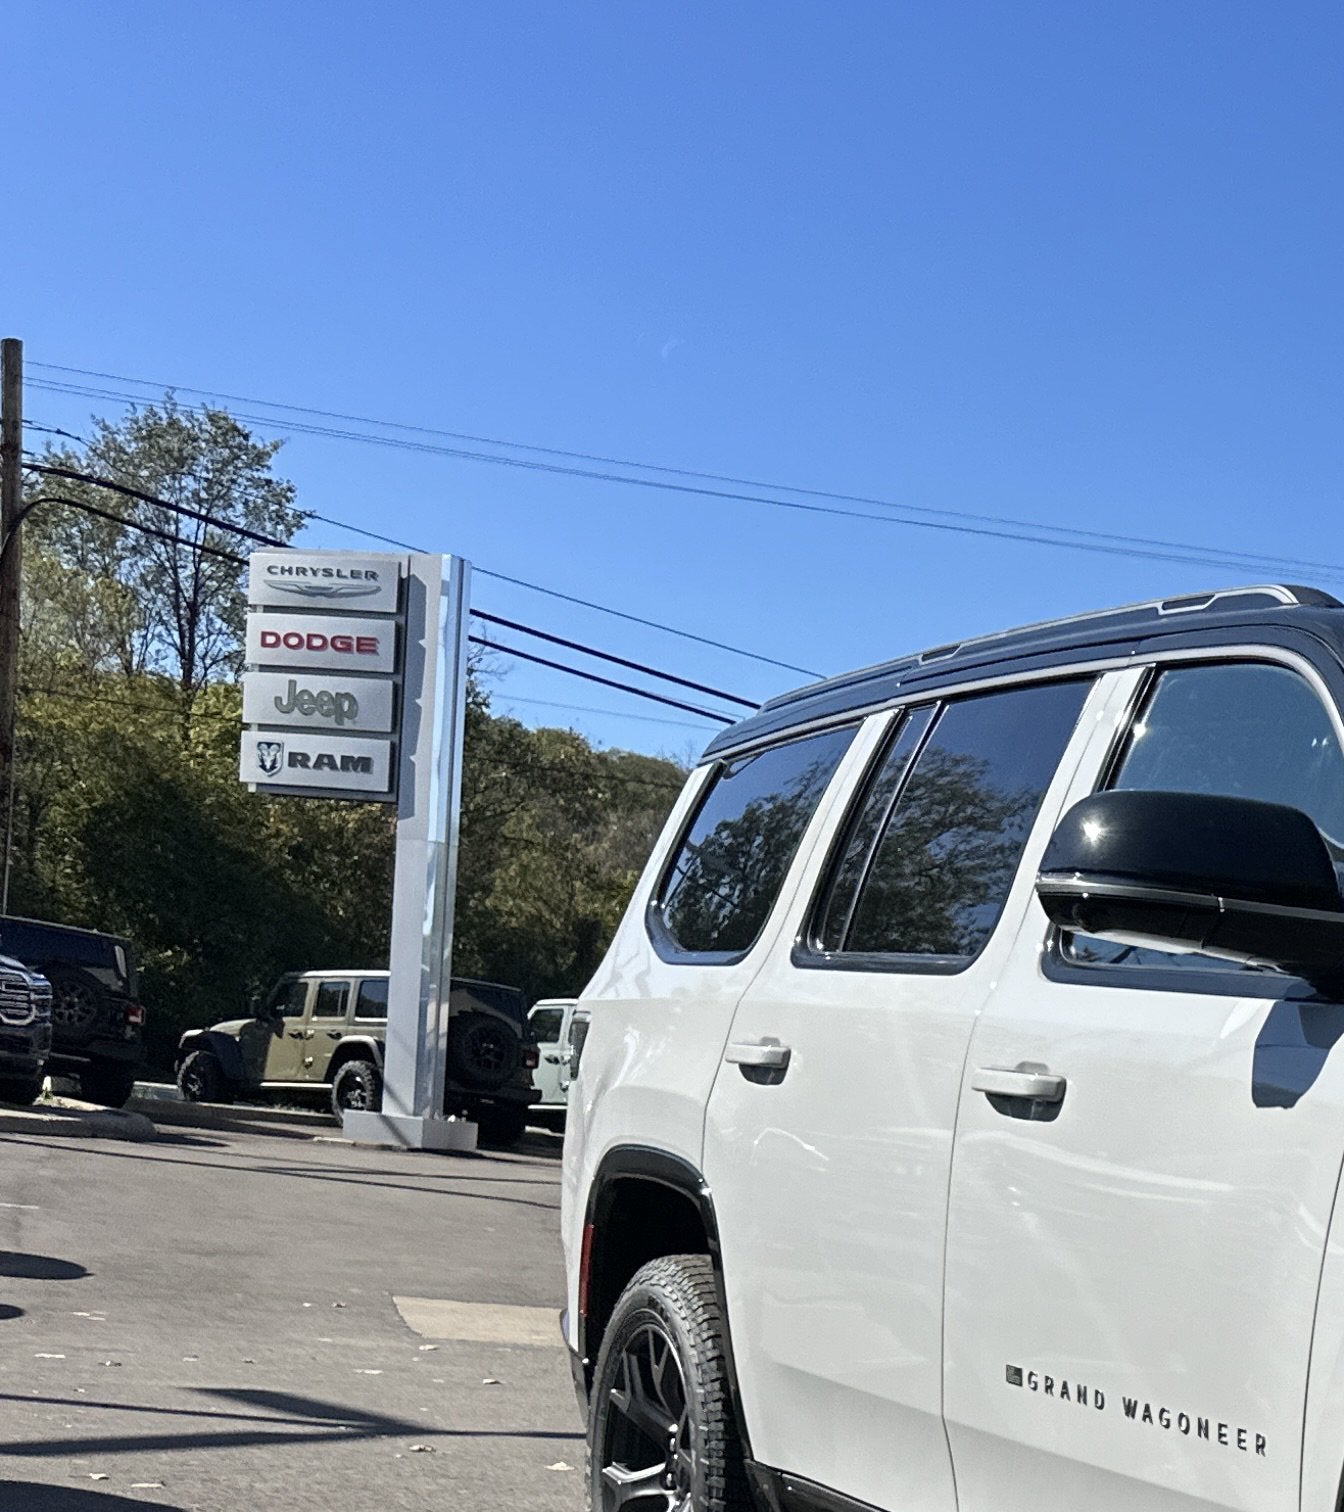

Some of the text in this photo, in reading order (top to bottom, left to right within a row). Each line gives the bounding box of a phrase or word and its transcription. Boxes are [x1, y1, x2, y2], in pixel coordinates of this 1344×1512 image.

[266, 564, 379, 582] CHRYSLER
[260, 631, 380, 656] DODGE
[273, 678, 359, 725] Jeep
[287, 750, 373, 774] RAM
[1027, 1370, 1267, 1457] GRAND WAGONEER
